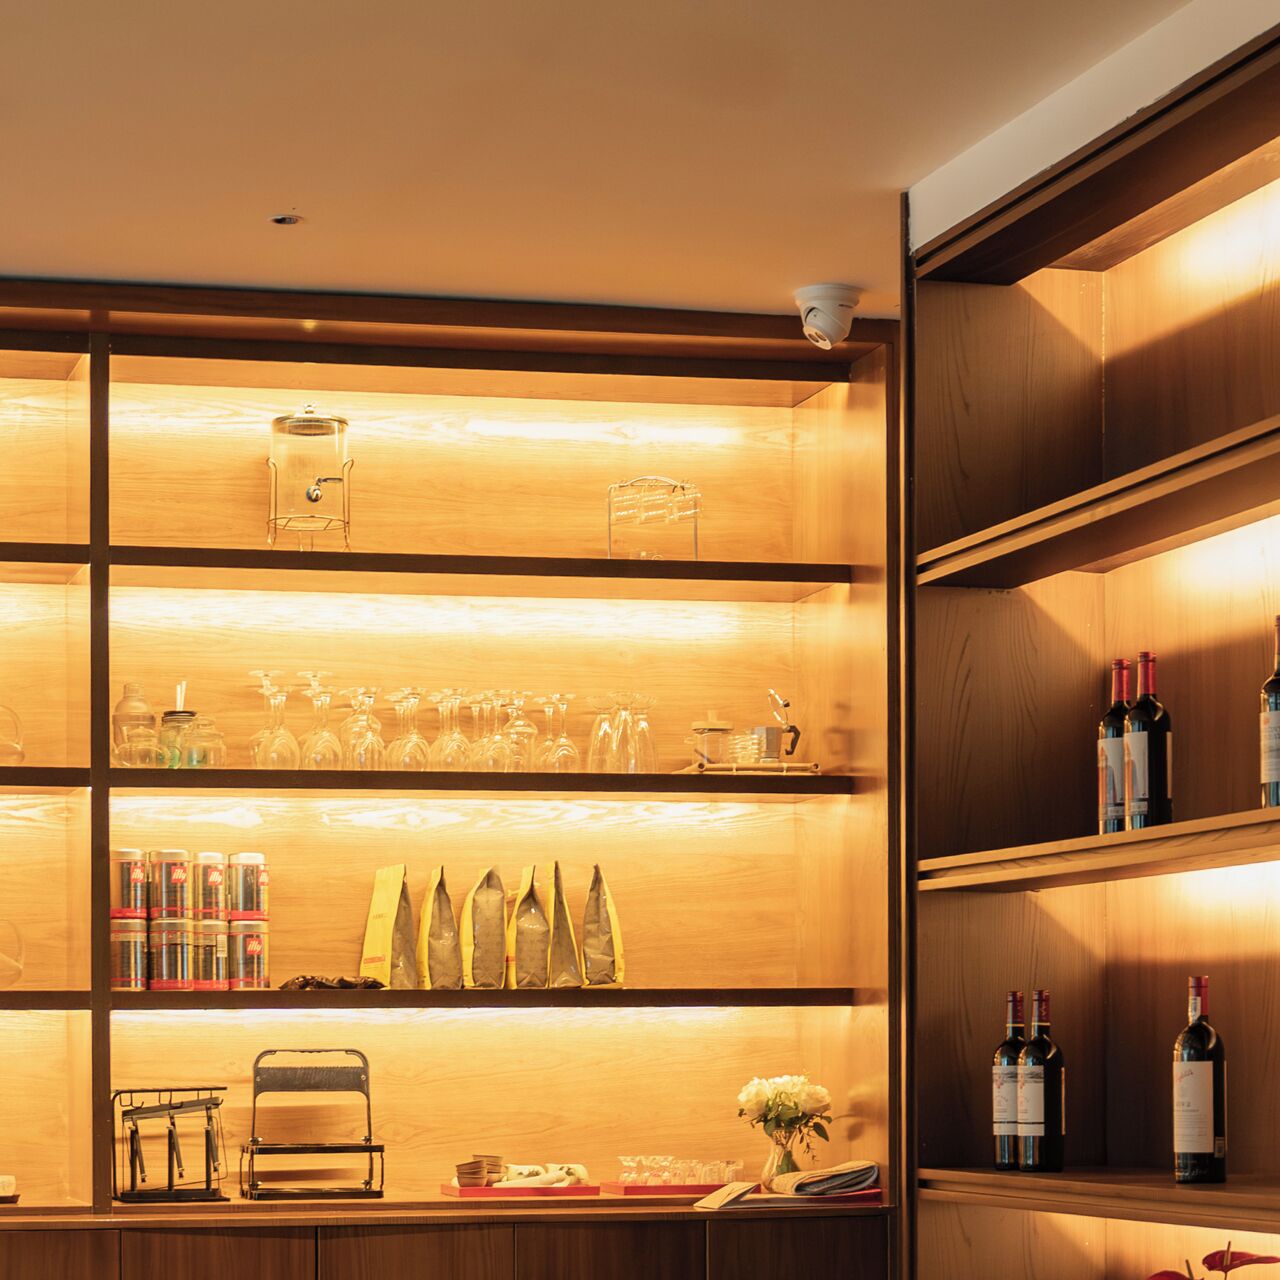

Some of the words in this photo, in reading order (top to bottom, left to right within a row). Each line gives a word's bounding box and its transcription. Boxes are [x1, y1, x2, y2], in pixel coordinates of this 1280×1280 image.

[132, 868, 144, 881] illy
[173, 868, 187, 881] illy
[209, 870, 223, 884] illy
[247, 942, 262, 953] illy
